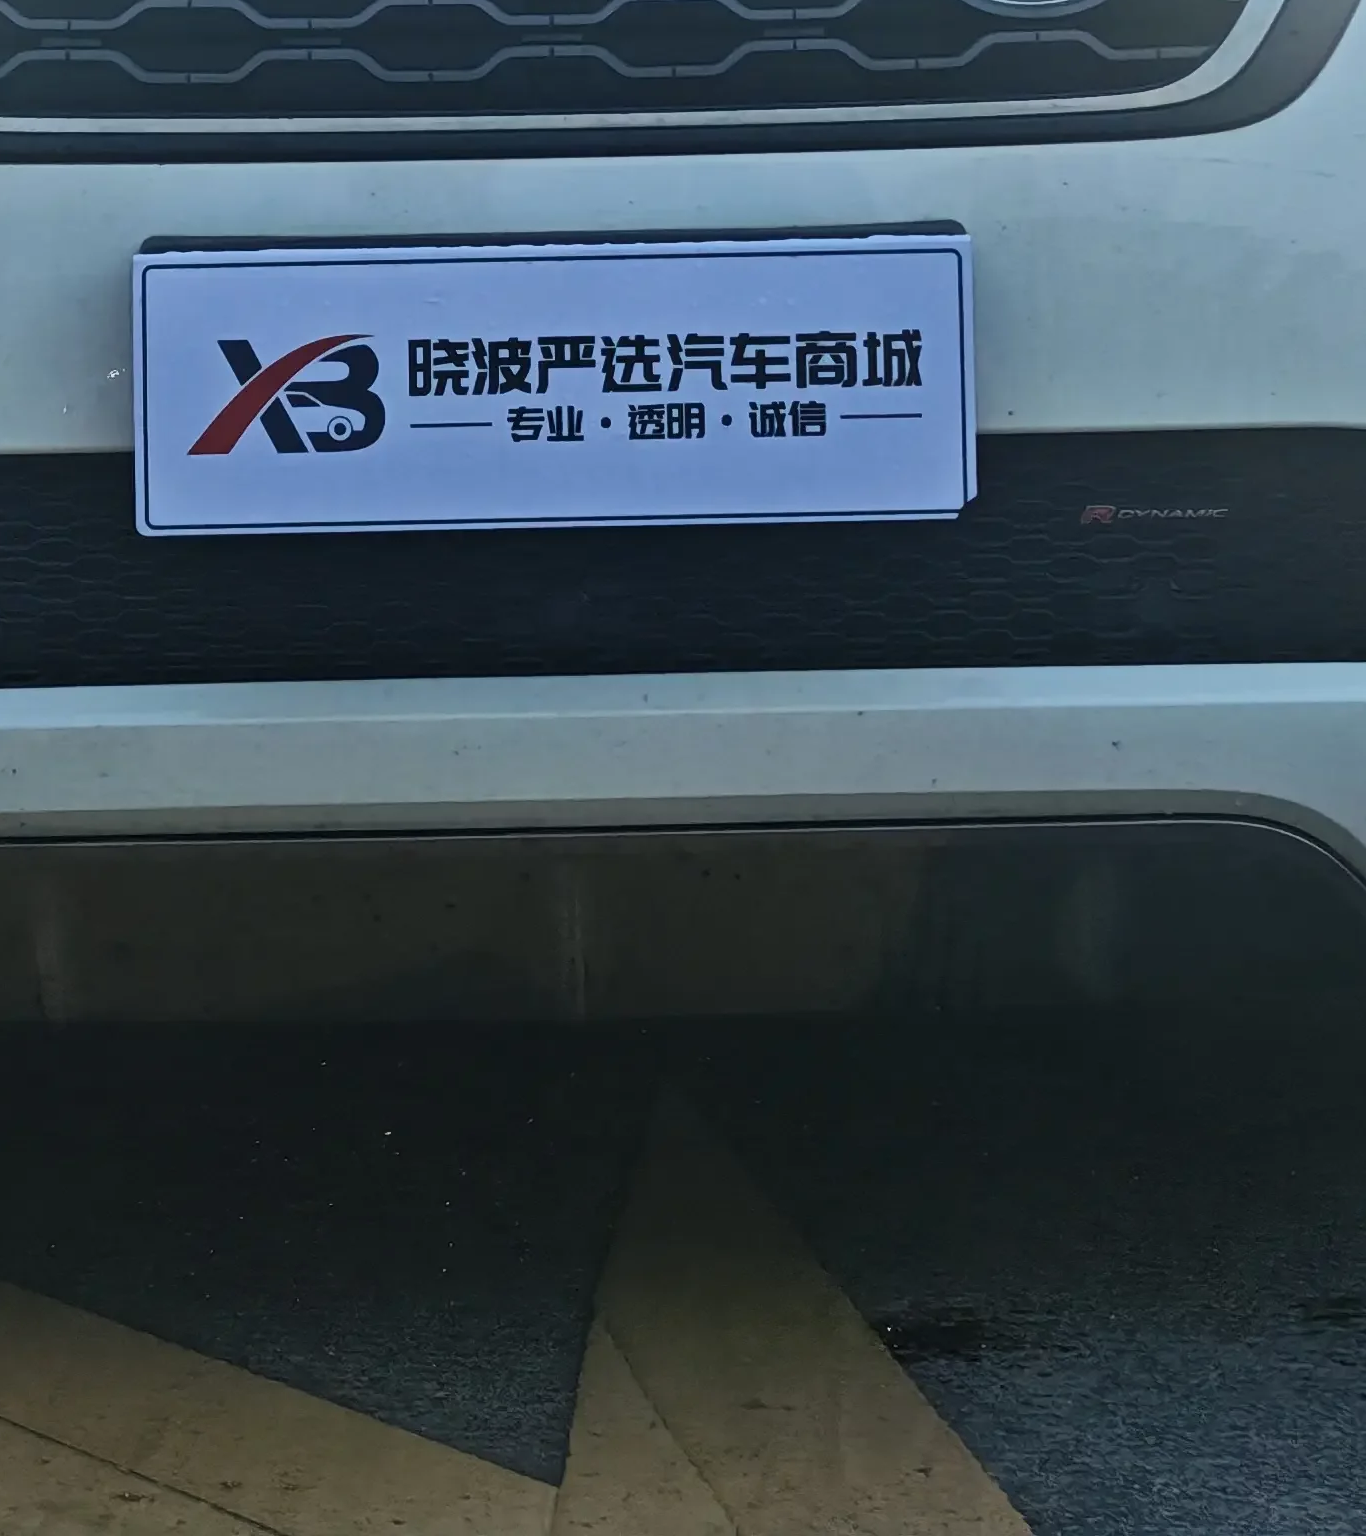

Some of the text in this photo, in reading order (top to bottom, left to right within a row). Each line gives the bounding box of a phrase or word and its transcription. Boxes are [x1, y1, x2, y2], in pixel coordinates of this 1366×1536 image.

[408, 329, 924, 397] 晓波严选汽车商城
[1117, 508, 1229, 519] DYNAMIC
